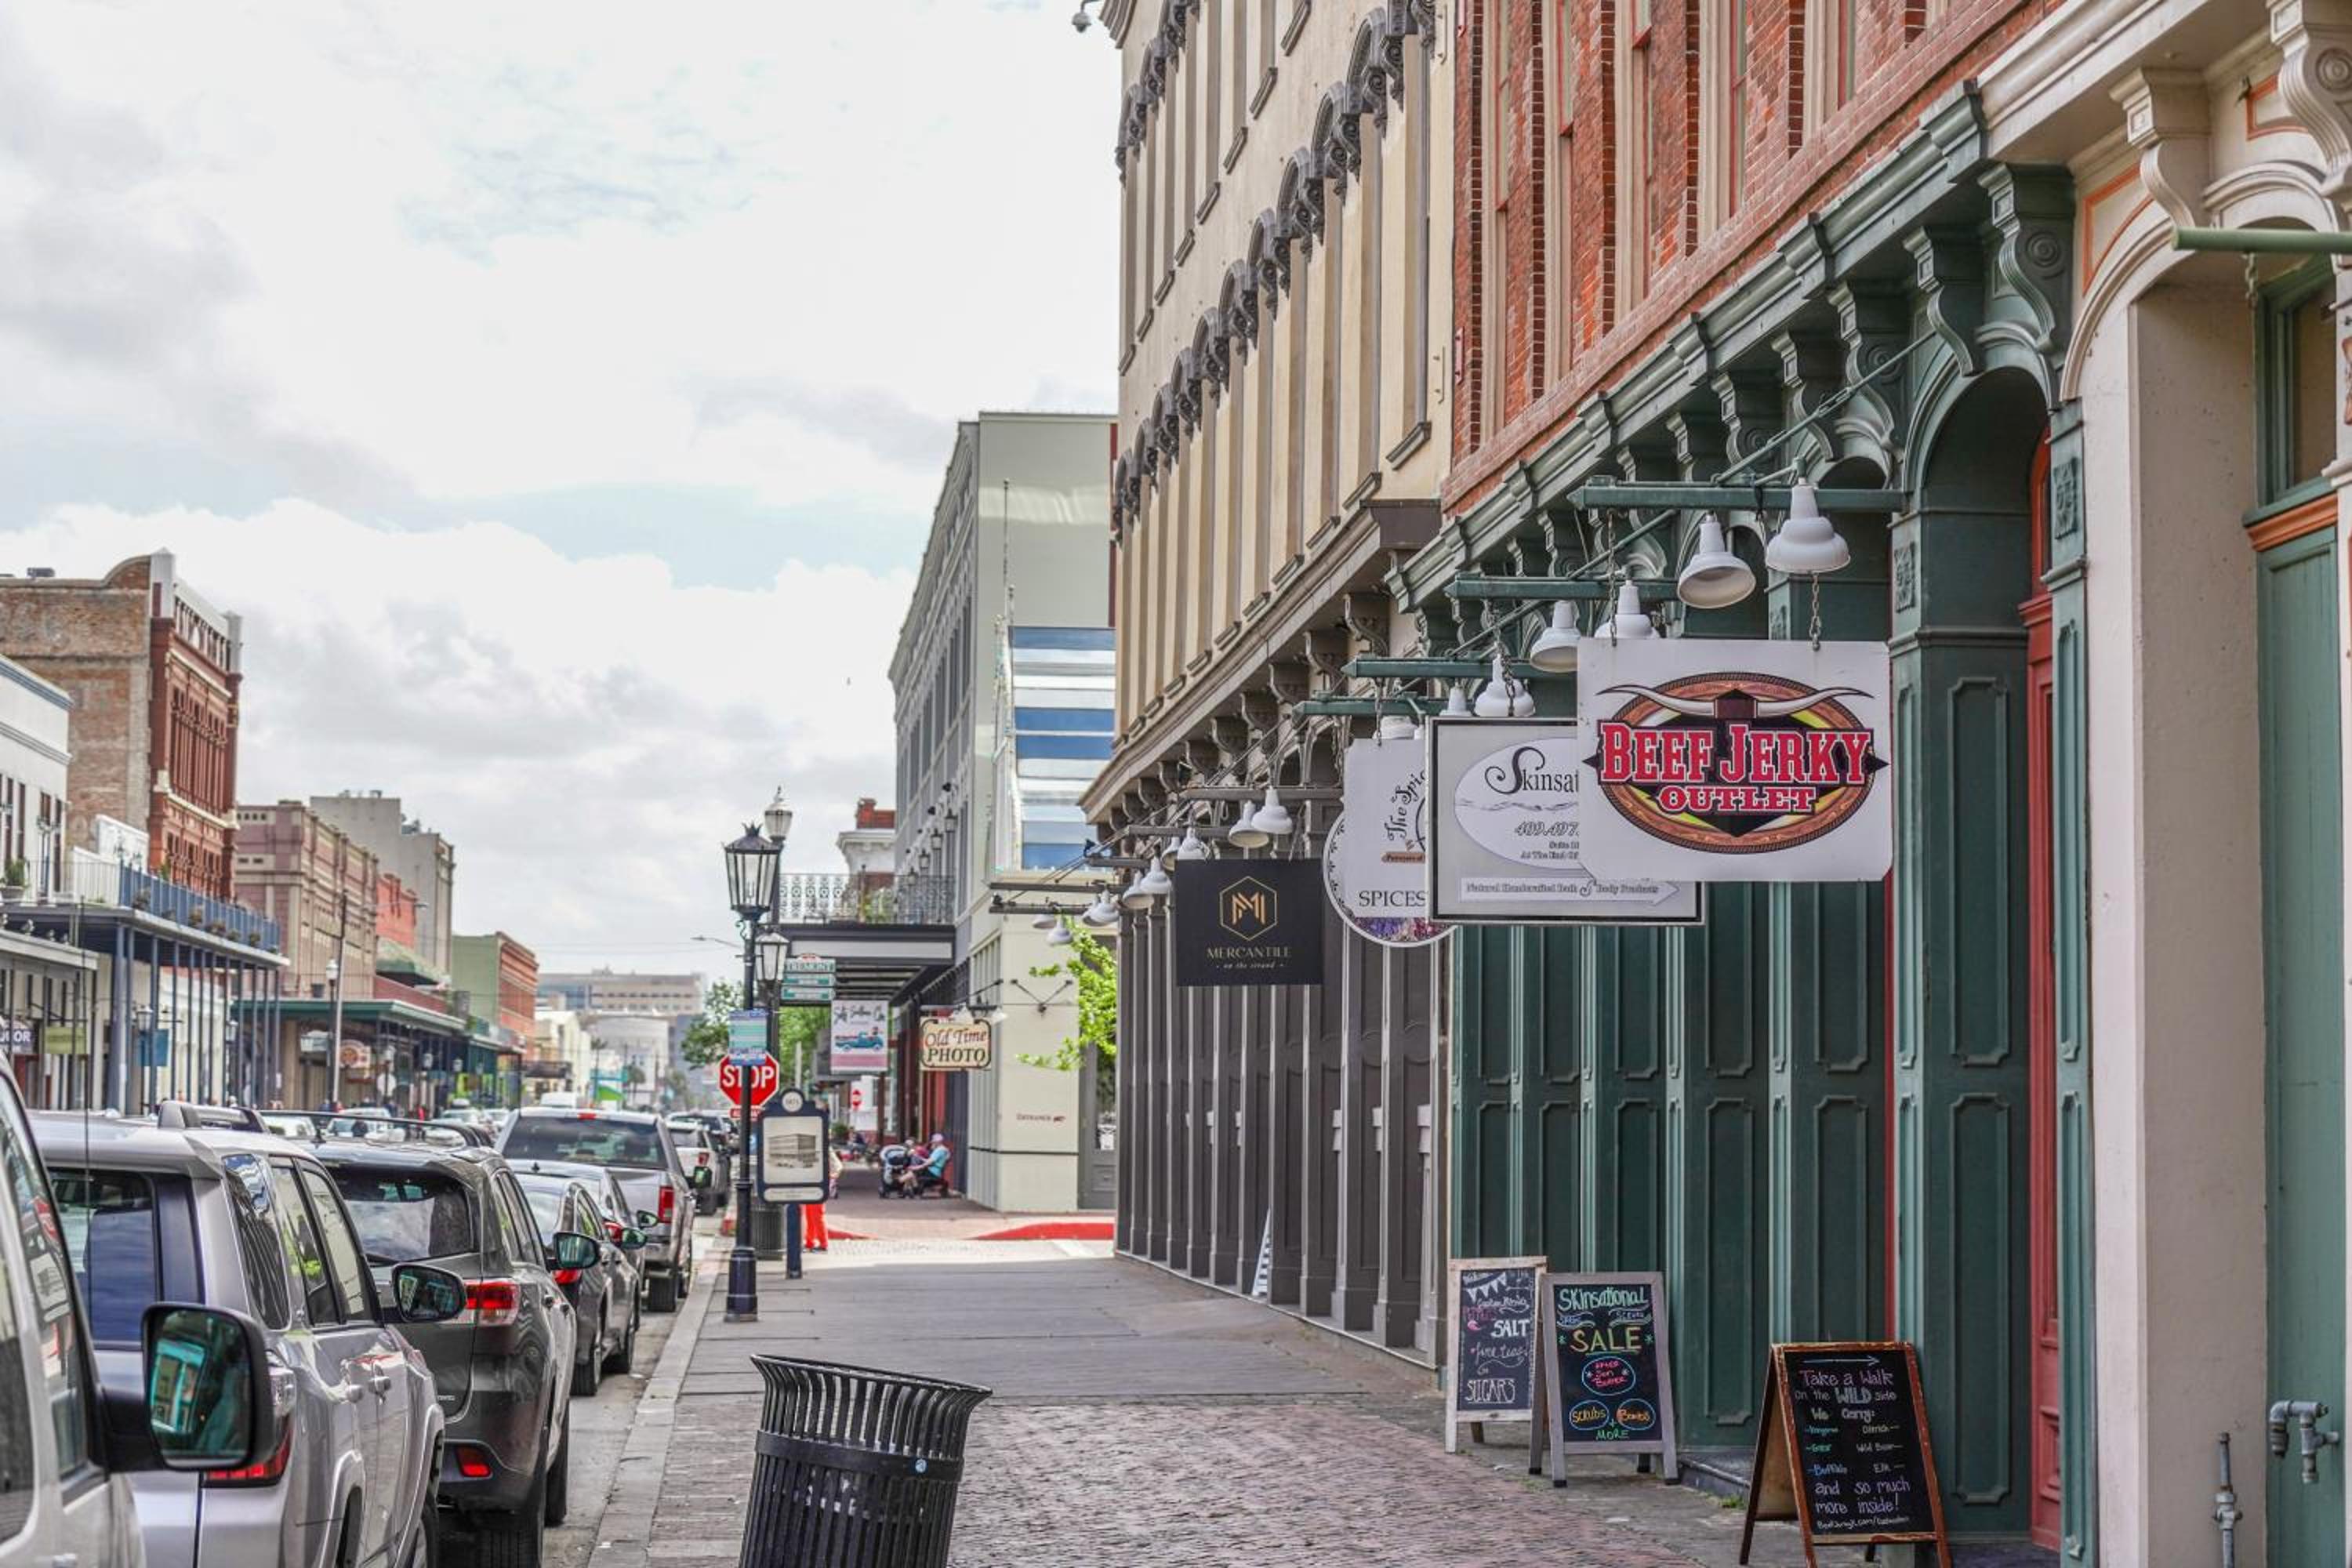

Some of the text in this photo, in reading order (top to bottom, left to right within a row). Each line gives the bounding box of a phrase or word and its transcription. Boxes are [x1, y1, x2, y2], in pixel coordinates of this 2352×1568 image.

[1600, 722, 1871, 785] BEEF JERKY
[1657, 786, 1817, 813] OUTLET
[1359, 890, 1426, 907] SPICES
[1207, 946, 1291, 959] MERCANTILE
[925, 1027, 986, 1048] Old Time
[927, 1047, 985, 1063] PHOTO
[1490, 1319, 1530, 1338] SALT
[1570, 1326, 1642, 1352] SALE
[1798, 1368, 1894, 1387] Take a Walk
[1835, 1386, 1872, 1403] WILD
[1815, 1480, 1841, 1495] and
[1877, 1475, 1911, 1494] much
[1815, 1502, 1848, 1514] more
